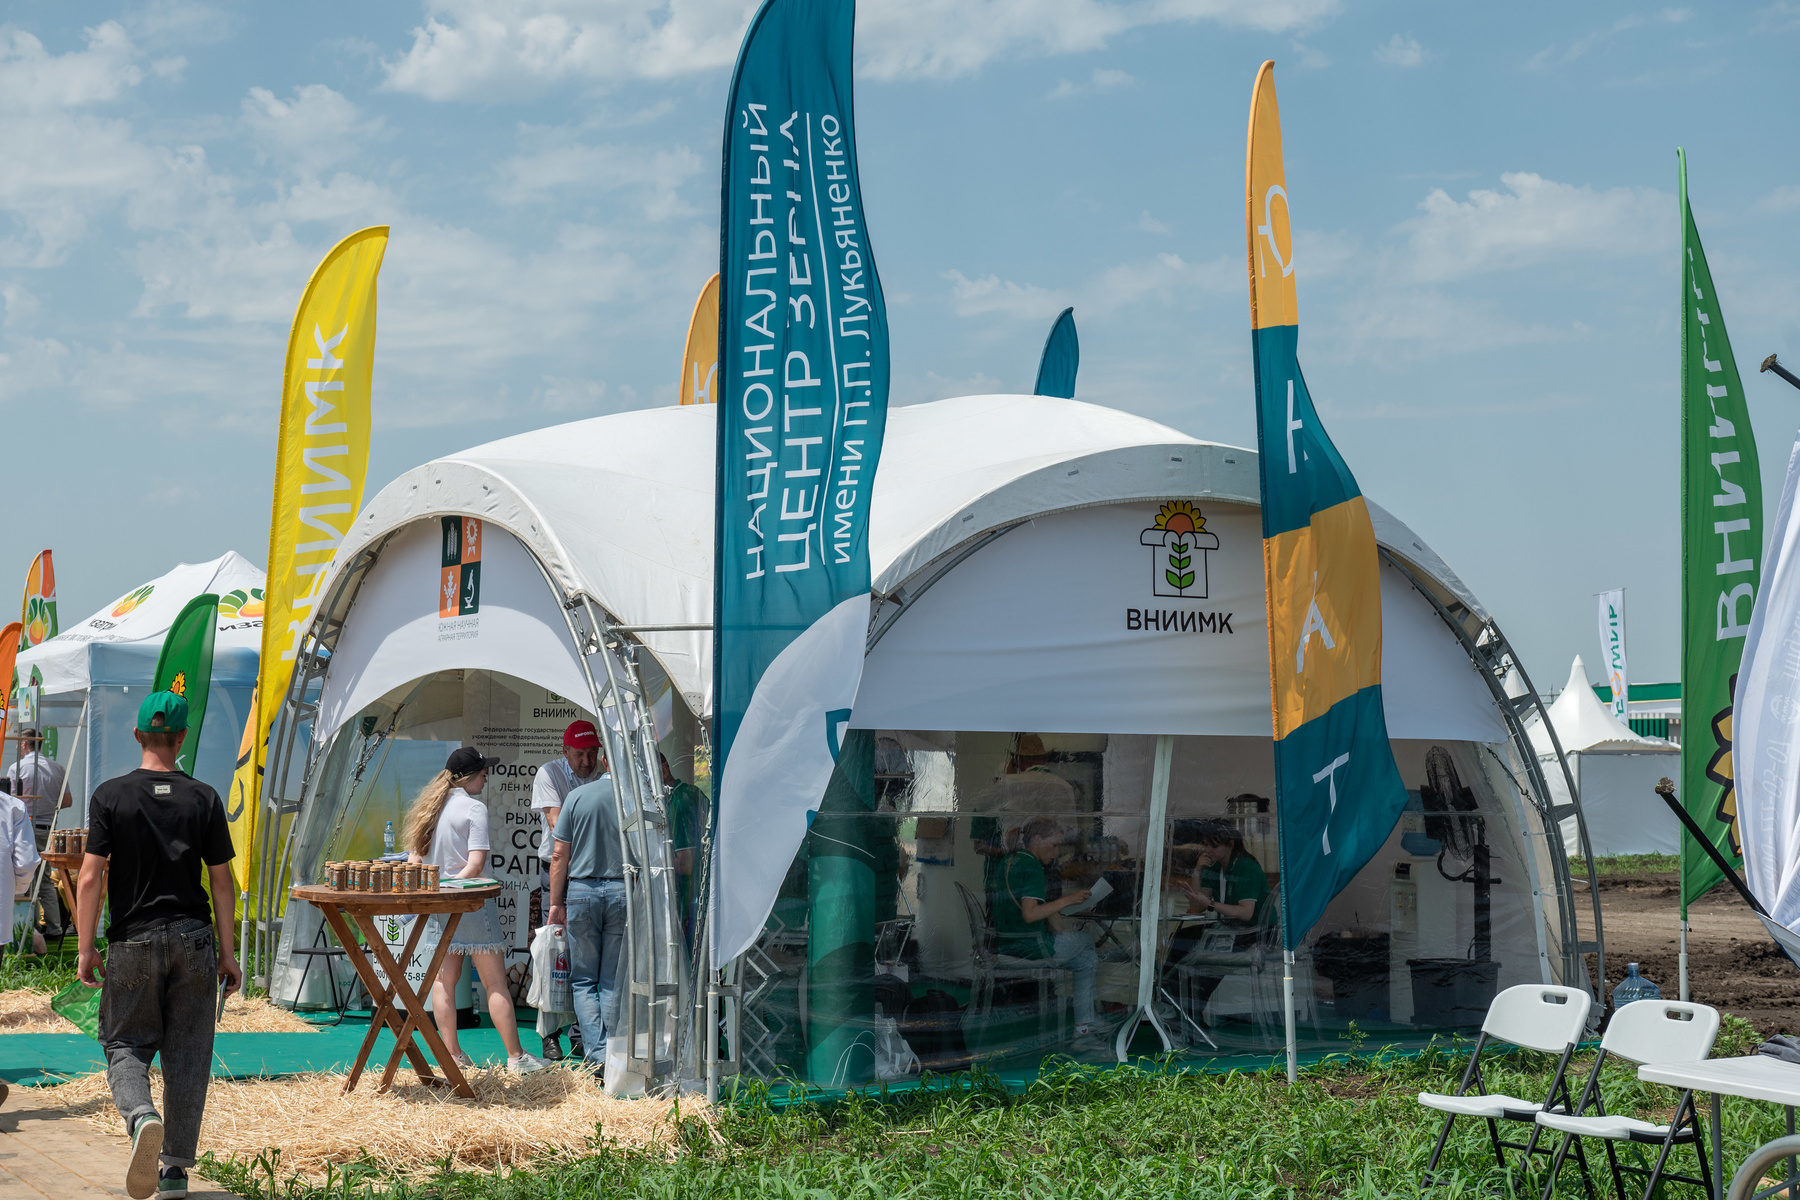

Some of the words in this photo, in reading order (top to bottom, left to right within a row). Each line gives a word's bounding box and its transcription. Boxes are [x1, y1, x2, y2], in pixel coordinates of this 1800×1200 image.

[820, 114, 873, 340] Лукьяненко
[742, 103, 778, 580] НАЦИОНАЛЬНЫЙ
[775, 350, 823, 573] ЦЕНТР
[1687, 247, 1754, 642] ВНИИ
[833, 440, 865, 564] имени
[1126, 608, 1234, 634] ВНИИМК
[533, 708, 577, 718] ВНИИМК
[500, 782, 520, 791] ЛЁН
[505, 812, 542, 825] РЫЖ
[491, 854, 540, 875] РАП
